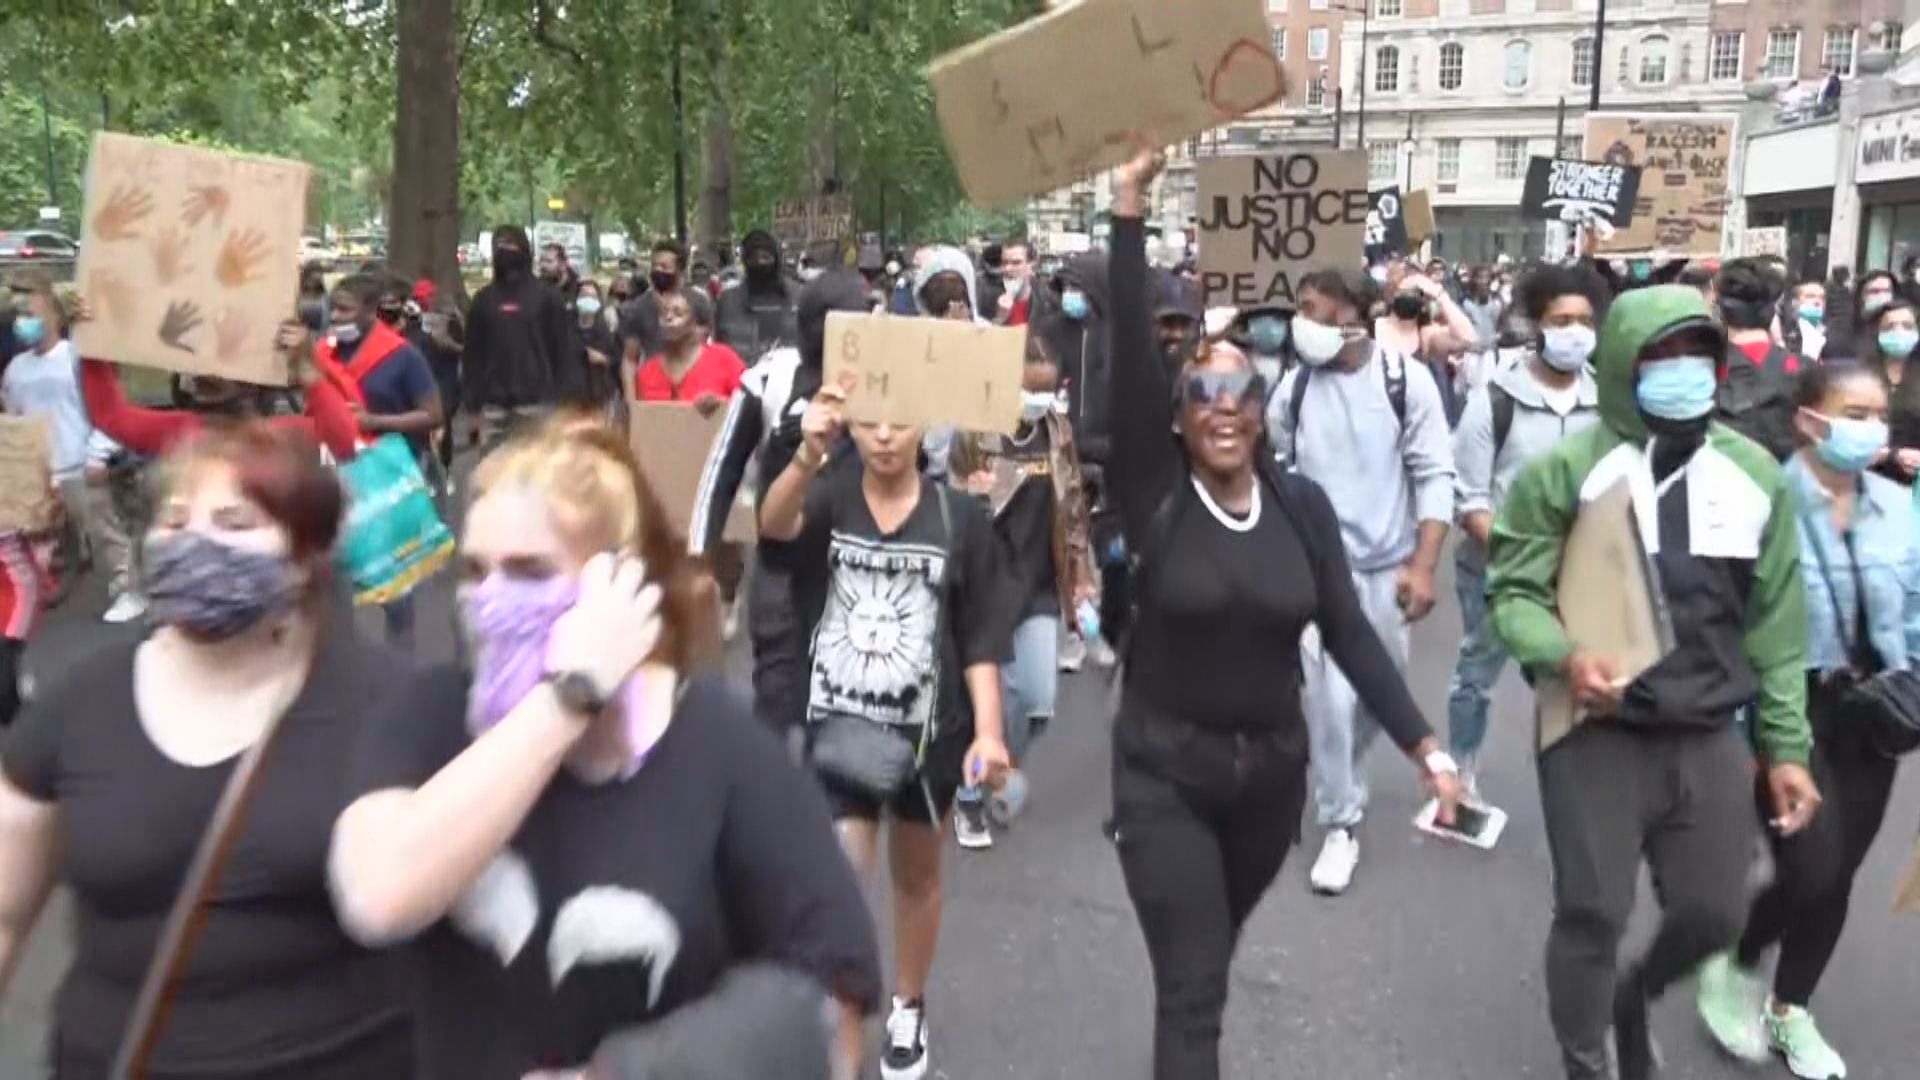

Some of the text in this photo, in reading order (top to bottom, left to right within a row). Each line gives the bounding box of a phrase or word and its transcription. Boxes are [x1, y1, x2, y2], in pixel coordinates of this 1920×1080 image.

[1254, 154, 1319, 191] NO
[1548, 160, 1624, 185] STRONGER
[1548, 180, 1620, 202] TOGETHER
[1200, 189, 1368, 231] JUSTICE
[1252, 227, 1316, 262] NO
[1203, 271, 1300, 305] PEA
